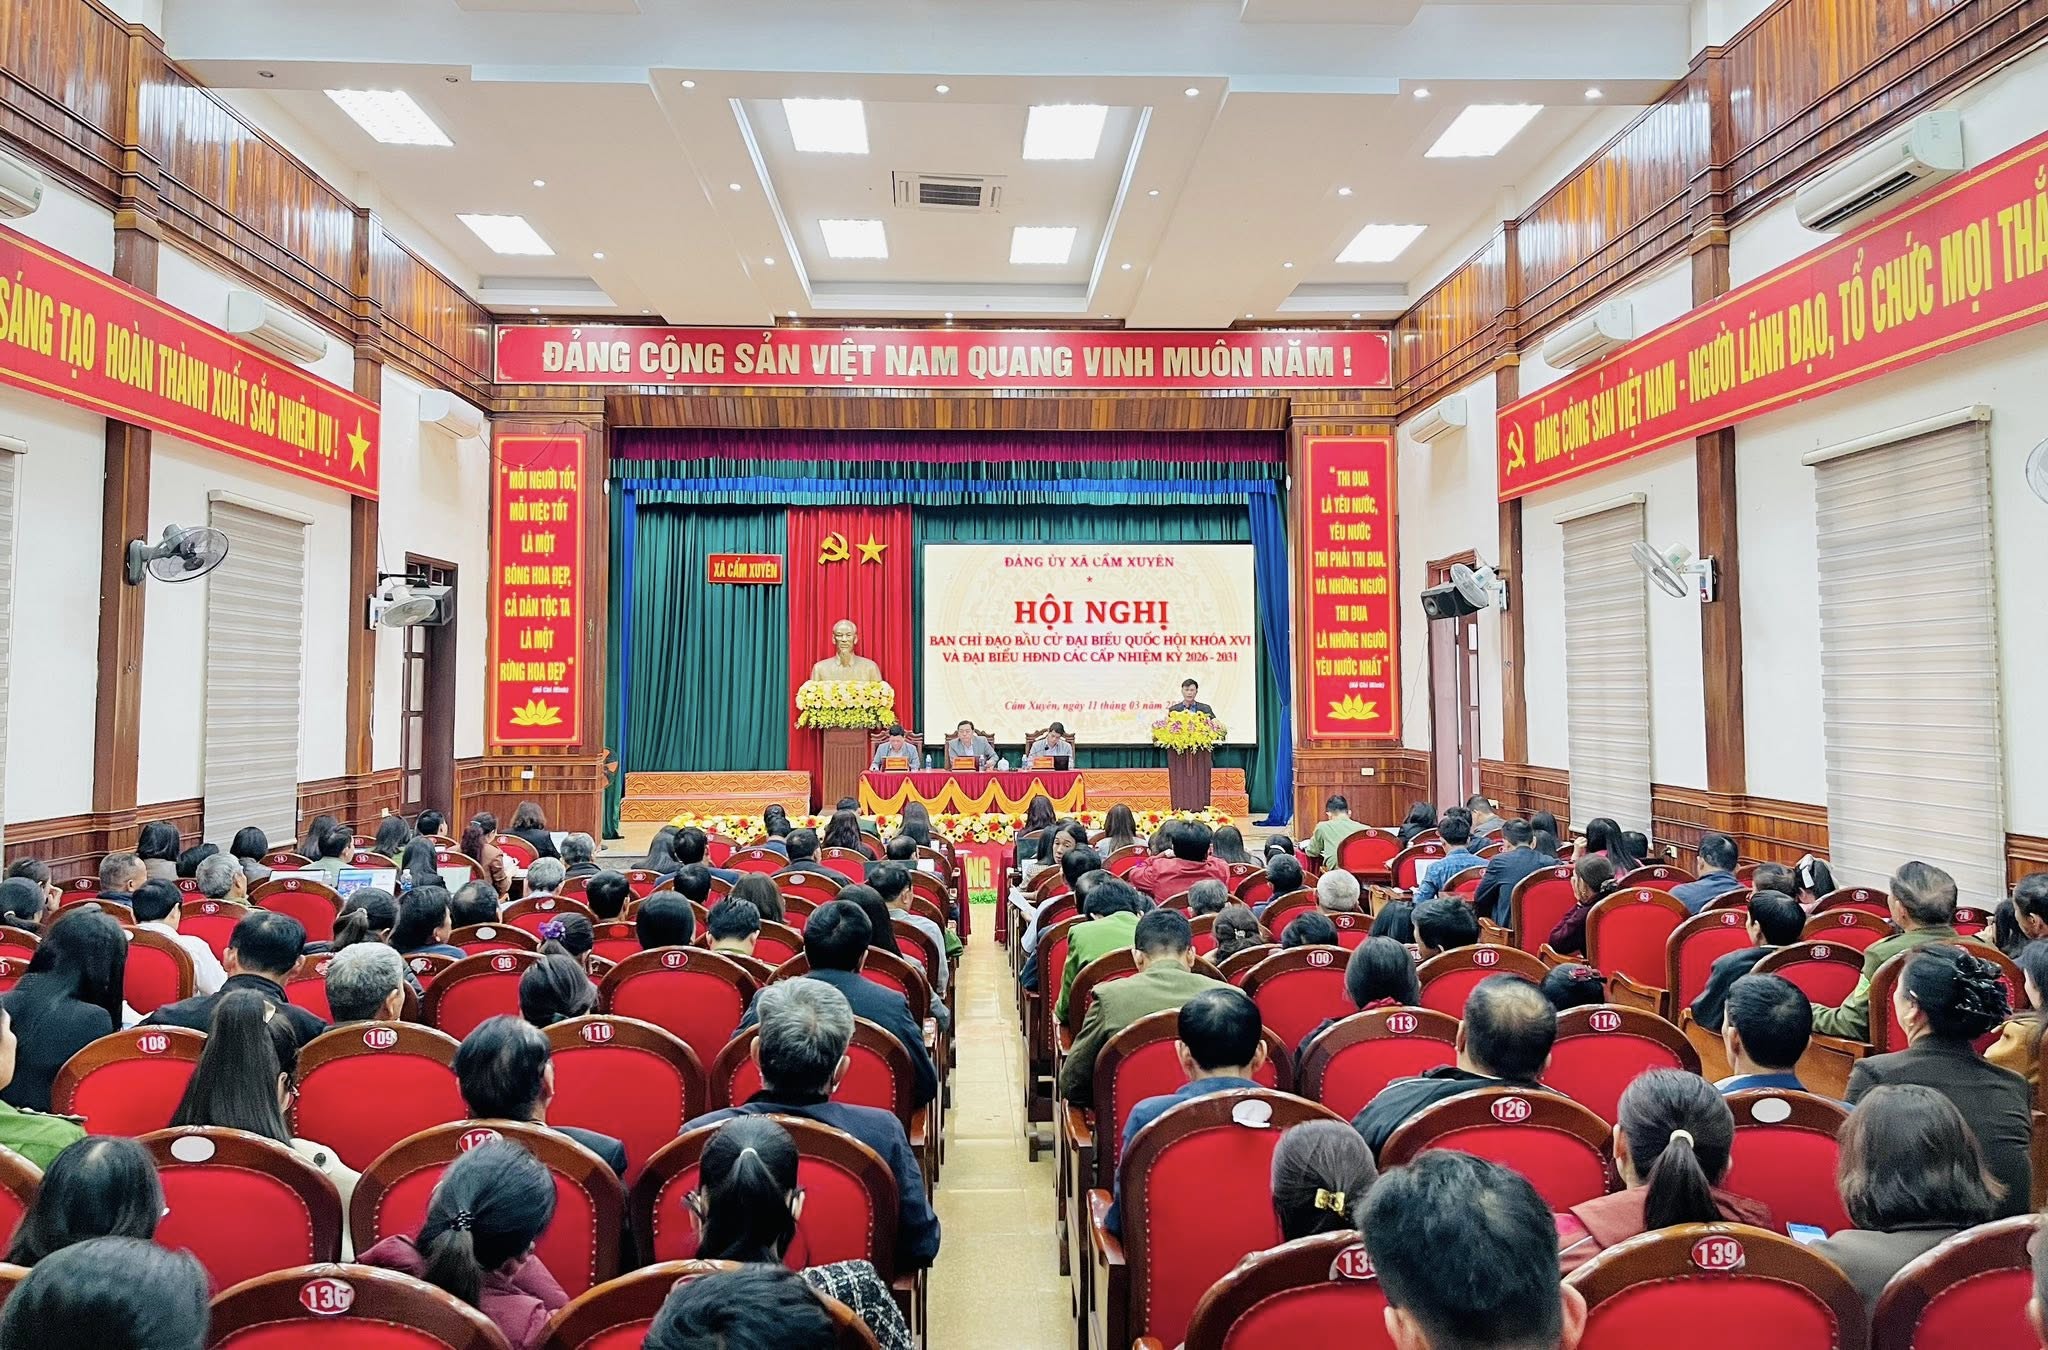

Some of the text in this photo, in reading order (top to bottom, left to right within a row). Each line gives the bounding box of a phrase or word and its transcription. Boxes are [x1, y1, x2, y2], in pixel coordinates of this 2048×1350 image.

[1534, 400, 1560, 463] ĐẢNG
[1562, 396, 1590, 460] CỘNG
[1592, 372, 1615, 441] SẢN
[1617, 368, 1642, 438] VIỆT
[1645, 359, 1677, 420] NAM
[1688, 322, 1734, 403] NGƯỜI
[1738, 309, 1785, 383] LÃNH
[1789, 295, 1835, 375] ĐẠO,
[1838, 246, 1865, 344] TỔ
[1870, 231, 1934, 332] CHỨC
[1940, 217, 1992, 314] MỌI
[542, 329, 632, 373] ĐẢNG
[640, 335, 725, 381] CỘNG
[733, 331, 800, 375] SẢN
[810, 338, 877, 382] VIỆT
[886, 344, 959, 377] NAM
[968, 345, 1073, 381] QUANG
[1082, 346, 1155, 378] VINH
[1163, 339, 1253, 378] MUÔN
[1262, 339, 1334, 378] NĂM
[0, 270, 54, 357] SÁNG
[60, 302, 96, 379] TẠO
[105, 321, 155, 393] HOÀN
[158, 341, 209, 412] THÀNH
[212, 360, 248, 426] XUẤT
[250, 372, 276, 437] SẮC
[278, 395, 316, 458] NHIỆM
[318, 411, 332, 467] VỤ
[529, 466, 558, 489] NGƯỜI
[1337, 470, 1351, 487] THI
[529, 498, 550, 525] VIỆC
[551, 496, 568, 521] TỐT
[1334, 494, 1350, 513] YÊU
[1329, 521, 1371, 540] YÊU NƯỚC
[535, 530, 555, 557] MỘT
[1004, 554, 1044, 568] ĐẢNG
[1048, 553, 1066, 568] ỦY
[1070, 554, 1089, 568] XÃ
[1127, 554, 1175, 568] XUYÊN
[1330, 546, 1350, 567] PHẢI
[1352, 551, 1365, 567] THI
[531, 566, 550, 585] HOA
[713, 557, 778, 578] XÃ CẨM XUYÊN
[1329, 576, 1358, 594] NHỮNG
[1360, 574, 1386, 594] NGƯỜI
[519, 594, 539, 617] DÂN
[541, 594, 558, 621] TỘC
[560, 598, 571, 617] TA
[1014, 593, 1169, 630] HỘI NGHỊ
[1335, 605, 1349, 621] THI
[534, 626, 554, 653] MỘT
[930, 635, 956, 646] BAN
[959, 632, 982, 646] CHỈ
[985, 635, 1012, 649] ĐẠO
[1015, 631, 1041, 646] BẦU
[1043, 632, 1063, 646] CỬ
[1066, 635, 1088, 649] ĐẠI
[1125, 631, 1160, 648] QUỐC
[1164, 632, 1187, 649] HỘI
[1190, 632, 1226, 646] KHÓA
[1230, 635, 1250, 646] XVI
[1329, 629, 1359, 648] NHỮNG
[1361, 628, 1387, 648] NGƯỜI
[942, 649, 960, 662] VÀ
[963, 651, 985, 665] ĐẠI
[1023, 651, 1060, 662] HĐND
[1063, 649, 1088, 662] CÁC
[1090, 647, 1114, 662] CẤP
[1118, 649, 1162, 665] NHIỆM
[1186, 651, 1208, 662] 2026
[1216, 651, 1238, 662] 2031
[1316, 654, 1382, 676] YÊU NƯỚC NHẤT
[527, 662, 546, 681] HOA
[1088, 701, 1098, 710] 11
[1101, 701, 1126, 712] tháng
[1129, 701, 1140, 710] 03
[967, 856, 991, 887] NG
[498, 957, 512, 969] 96
[667, 953, 681, 966] 97
[1310, 952, 1329, 965] 100
[1476, 952, 1496, 965] 101
[1389, 1016, 1413, 1030] 113
[1594, 1015, 1618, 1029] 114
[368, 1030, 394, 1046] 109
[585, 1024, 611, 1040] 110
[141, 1035, 166, 1051] 108
[1496, 1102, 1525, 1118] 126
[1342, 1250, 1375, 1274] 13
[1698, 1241, 1738, 1266] 139
[306, 1284, 350, 1309] 136
